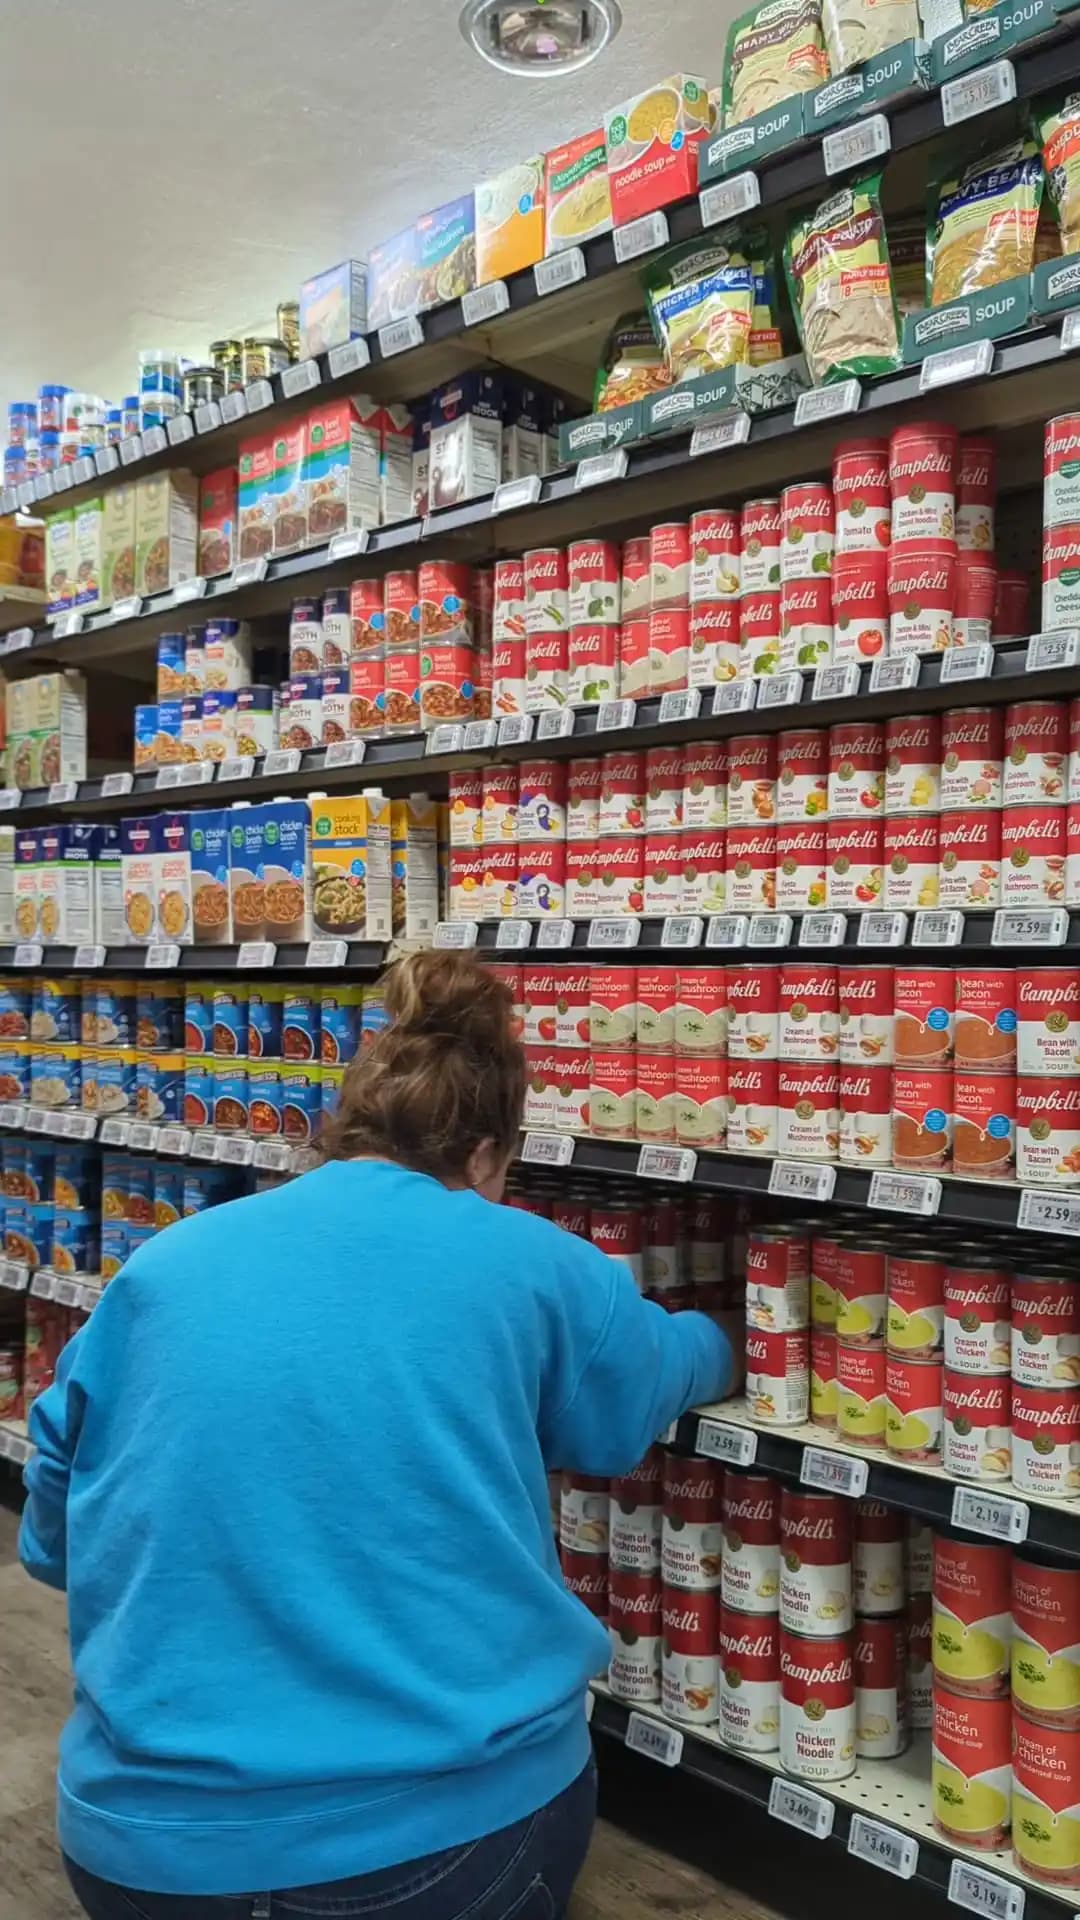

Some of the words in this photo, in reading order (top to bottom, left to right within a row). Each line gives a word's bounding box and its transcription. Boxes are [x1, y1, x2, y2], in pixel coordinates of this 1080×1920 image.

[1003, 2, 1044, 30] SOUP
[867, 62, 902, 87] SOUP
[757, 114, 790, 140] SOUP
[644, 158, 666, 176] soup
[975, 297, 1015, 322] SOUP
[697, 386, 727, 406] SOUP
[334, 823, 359, 836] stock
[1008, 873, 1032, 882] Golden
[1011, 921, 1040, 934] $2.59
[897, 979, 916, 989] bean
[917, 980, 936, 989] with
[961, 979, 985, 989] bean
[986, 980, 1004, 989] with
[896, 988, 922, 998] bacon
[961, 989, 991, 998] bacon
[1037, 1038, 1058, 1048] Bean
[1059, 1038, 1077, 1047] with
[1044, 1047, 1070, 1057] Bacon
[1046, 1063, 1070, 1071] SOUP
[915, 1080, 932, 1090] with
[977, 1085, 995, 1094] with
[956, 1094, 982, 1104] bacon
[1023, 1145, 1039, 1155] Bean
[1041, 1146, 1059, 1155] with
[1028, 1155, 1051, 1164] Bacon
[1028, 1170, 1050, 1178] SOUP
[1038, 1206, 1070, 1221] $2.59
[954, 1337, 977, 1347] Cream
[979, 1339, 987, 1348] of
[956, 1346, 986, 1358] Chicken
[1017, 1348, 1040, 1359] Cream
[1041, 1351, 1049, 1360] of
[859, 1356, 866, 1366] of
[959, 1360, 981, 1369] SOUP
[1019, 1358, 1048, 1370] Chicken
[839, 1362, 874, 1376] chicken
[1022, 1372, 1042, 1383] SOUP
[944, 1380, 1002, 1409] ampbell's
[710, 1433, 733, 1449] $2.59
[970, 1443, 978, 1452] of
[949, 1449, 976, 1462] Chicken
[952, 1464, 971, 1473] SOUP
[1026, 1458, 1051, 1469] Cream
[1053, 1462, 1062, 1471] of
[1028, 1468, 1060, 1480] Chicken
[1032, 1483, 1055, 1493] SOUP
[970, 1505, 999, 1522] $2.19
[637, 1534, 647, 1543] of
[617, 1554, 639, 1565] SOUP
[686, 1552, 695, 1561] of
[722, 1561, 751, 1578] Chicken
[957, 1560, 967, 1570] of
[724, 1574, 749, 1591] Noodle
[781, 1582, 811, 1600] Chicken
[1040, 1585, 1051, 1596] of
[724, 1592, 745, 1605] SOUP
[782, 1596, 809, 1613] Noodle
[1016, 1588, 1061, 1612] chicken
[784, 1614, 805, 1627] SOUP
[639, 1664, 648, 1675] of
[720, 1698, 750, 1715] Chicken
[721, 1710, 749, 1727] Noodle
[959, 1713, 969, 1723] of
[936, 1713, 978, 1737] chicken
[723, 1730, 744, 1742] SOUP
[796, 1731, 835, 1746] Chicken
[797, 1744, 834, 1758] Noodle
[1019, 1735, 1044, 1753] cream
[1046, 1746, 1057, 1755] of
[1019, 1746, 1067, 1771] chicken
[801, 1765, 830, 1776] SOUP
[865, 1834, 891, 1856] $3.69
[967, 1881, 996, 1905] $3.19
